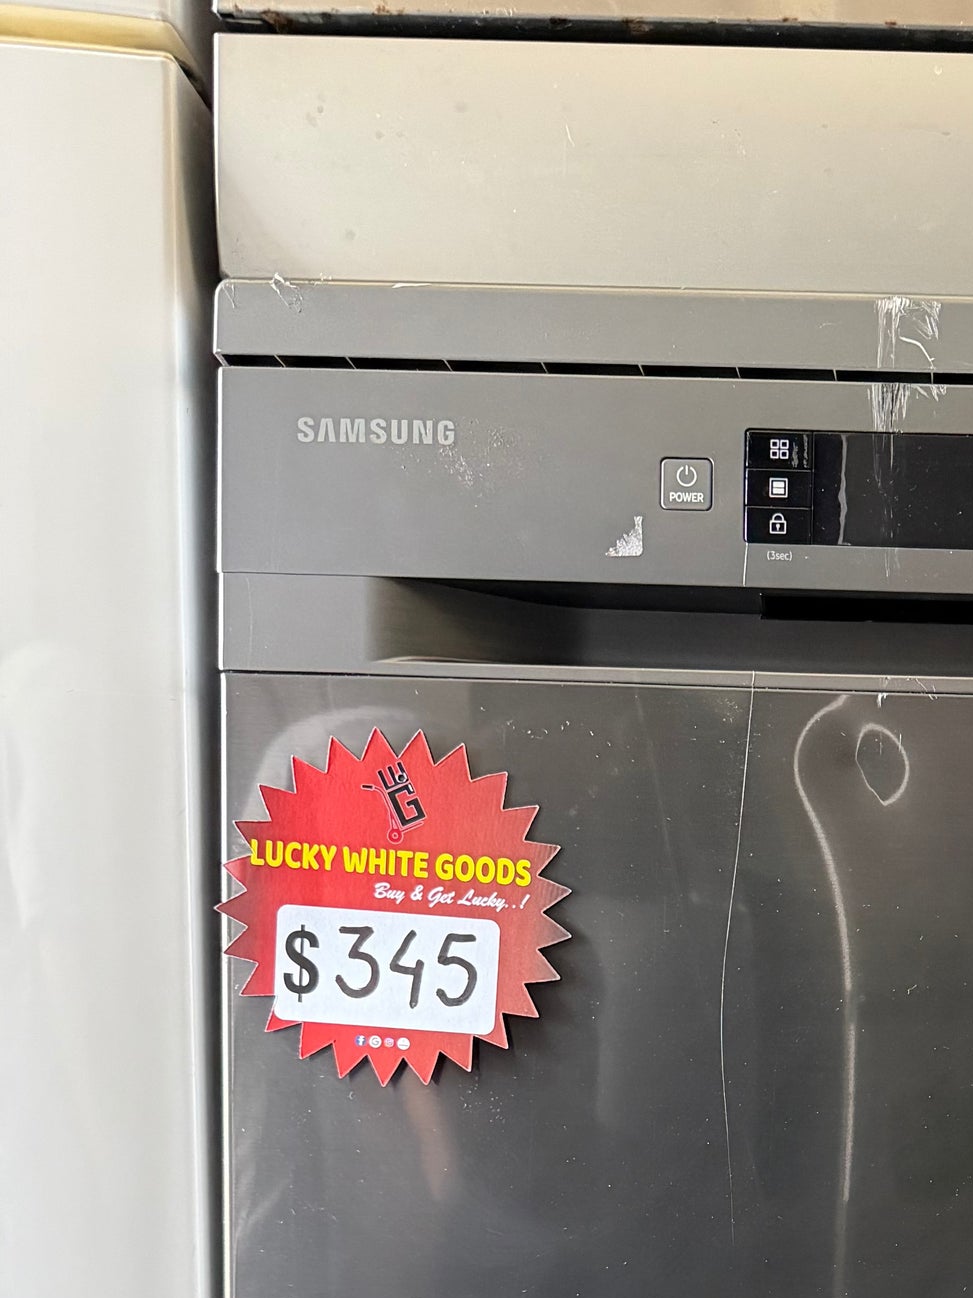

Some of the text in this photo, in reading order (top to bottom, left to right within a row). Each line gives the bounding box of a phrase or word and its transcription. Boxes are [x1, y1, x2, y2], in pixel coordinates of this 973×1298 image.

[297, 416, 455, 446] SAMSUNG
[669, 491, 704, 503] POWER
[766, 550, 793, 561] (3sec)
[250, 838, 532, 887] LUCKY WHITE GOODS
[373, 882, 406, 904] Buy
[410, 884, 424, 901] &
[427, 886, 456, 908] Get
